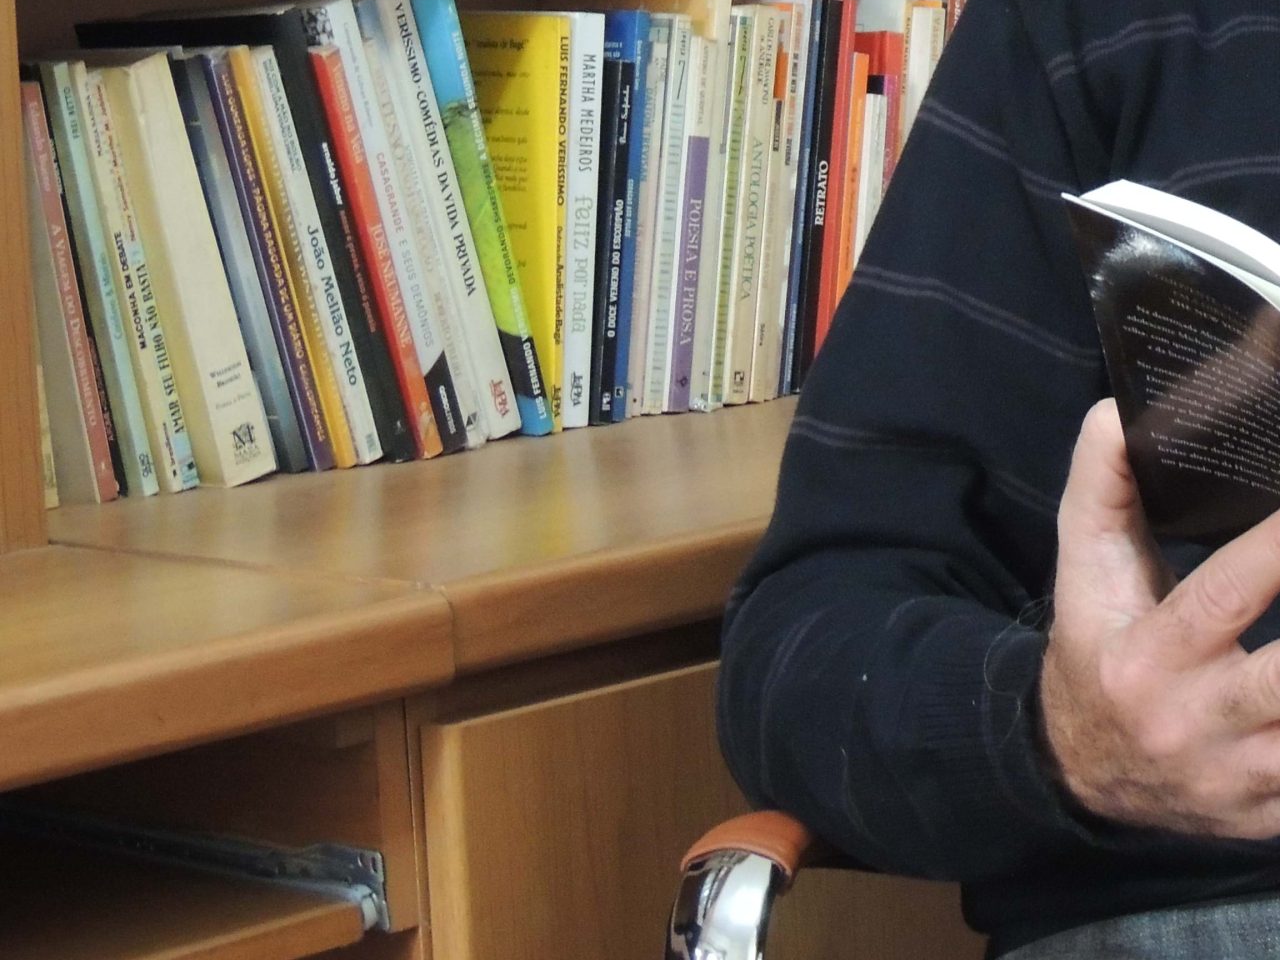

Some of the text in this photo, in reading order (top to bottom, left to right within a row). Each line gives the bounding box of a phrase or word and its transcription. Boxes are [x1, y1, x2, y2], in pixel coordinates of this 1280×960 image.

[450, 30, 465, 61] NOITE
[458, 65, 476, 111] SEGUNDA
[580, 54, 597, 103] MARTHA
[393, 2, 478, 297] VERÍSSIMO COMÉDIAS DA VIDA PRIVADA
[469, 113, 485, 150] DÉCIMA
[557, 36, 568, 207] LUIS FERNANDO VERÍSSIMO
[578, 108, 595, 172] MEDEIROS
[221, 74, 304, 359] LUIZ GONZAGA LOPES PÁGINA RASGADA DE UM DIÁRIO
[375, 152, 405, 233] CASAGRANDE
[480, 163, 502, 223] SHAKESPEARE
[574, 195, 594, 250] feliz
[739, 137, 764, 301] ANTOLOGIA POÉTICA
[813, 160, 829, 226] RETRATO
[400, 250, 417, 281] SEUS
[495, 226, 516, 285] DEVORANDO
[573, 258, 589, 288] por
[607, 199, 623, 338] O DOCE VENENO DO ESCORPIÃO
[680, 198, 701, 345] POESIA E PROSA
[113, 231, 149, 348] MACONHA EM DEBATE
[306, 225, 360, 387] João Mellão Neto
[408, 284, 434, 348] DEMÔNIOS
[51, 222, 97, 426] A VIAGEM DO DESCOBRIMENTO
[133, 264, 185, 434] AMAR SEU FILHO NÃO BASTA
[522, 342, 542, 395] FERNANDO
[534, 396, 547, 419] LUIS
